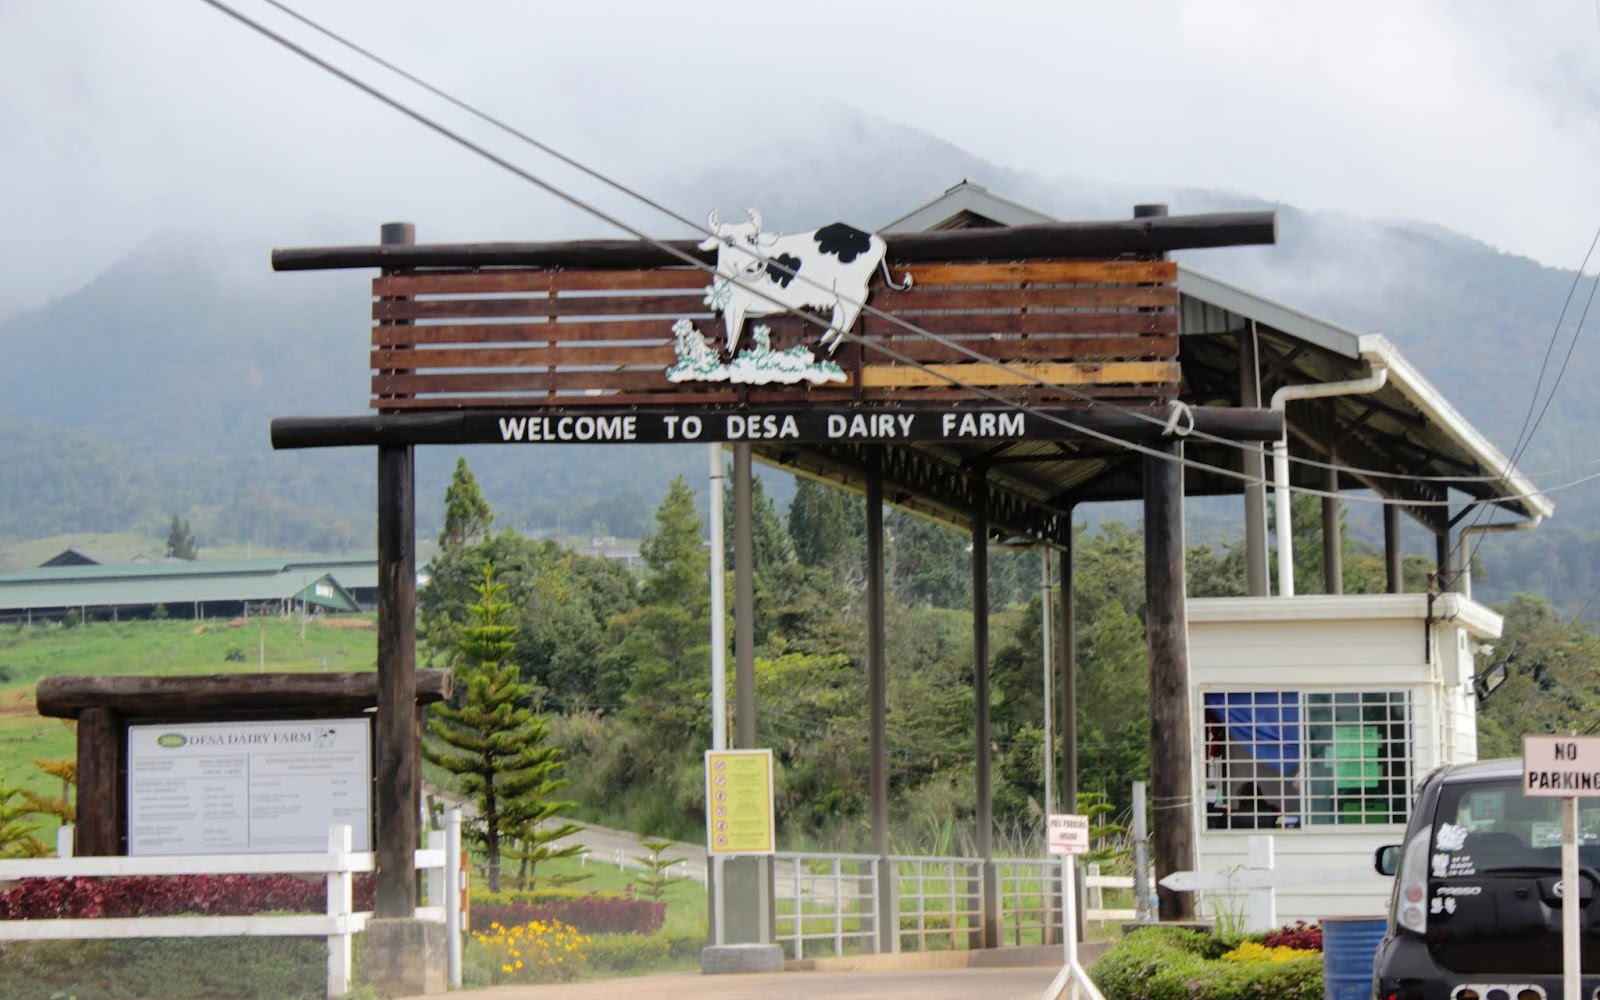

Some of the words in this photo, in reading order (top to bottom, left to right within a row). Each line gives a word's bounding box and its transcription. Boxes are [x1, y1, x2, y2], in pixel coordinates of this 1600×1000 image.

[498, 416, 637, 441] WELCOME
[663, 416, 702, 440] TO
[727, 414, 799, 439] DESA
[828, 413, 915, 438] DAIRY
[942, 412, 1026, 437] FARM
[189, 732, 225, 746] DESA
[227, 731, 271, 745] DAIRY
[272, 729, 312, 744] FARM
[1554, 743, 1577, 761] NO
[1528, 771, 1600, 790] PARKING
